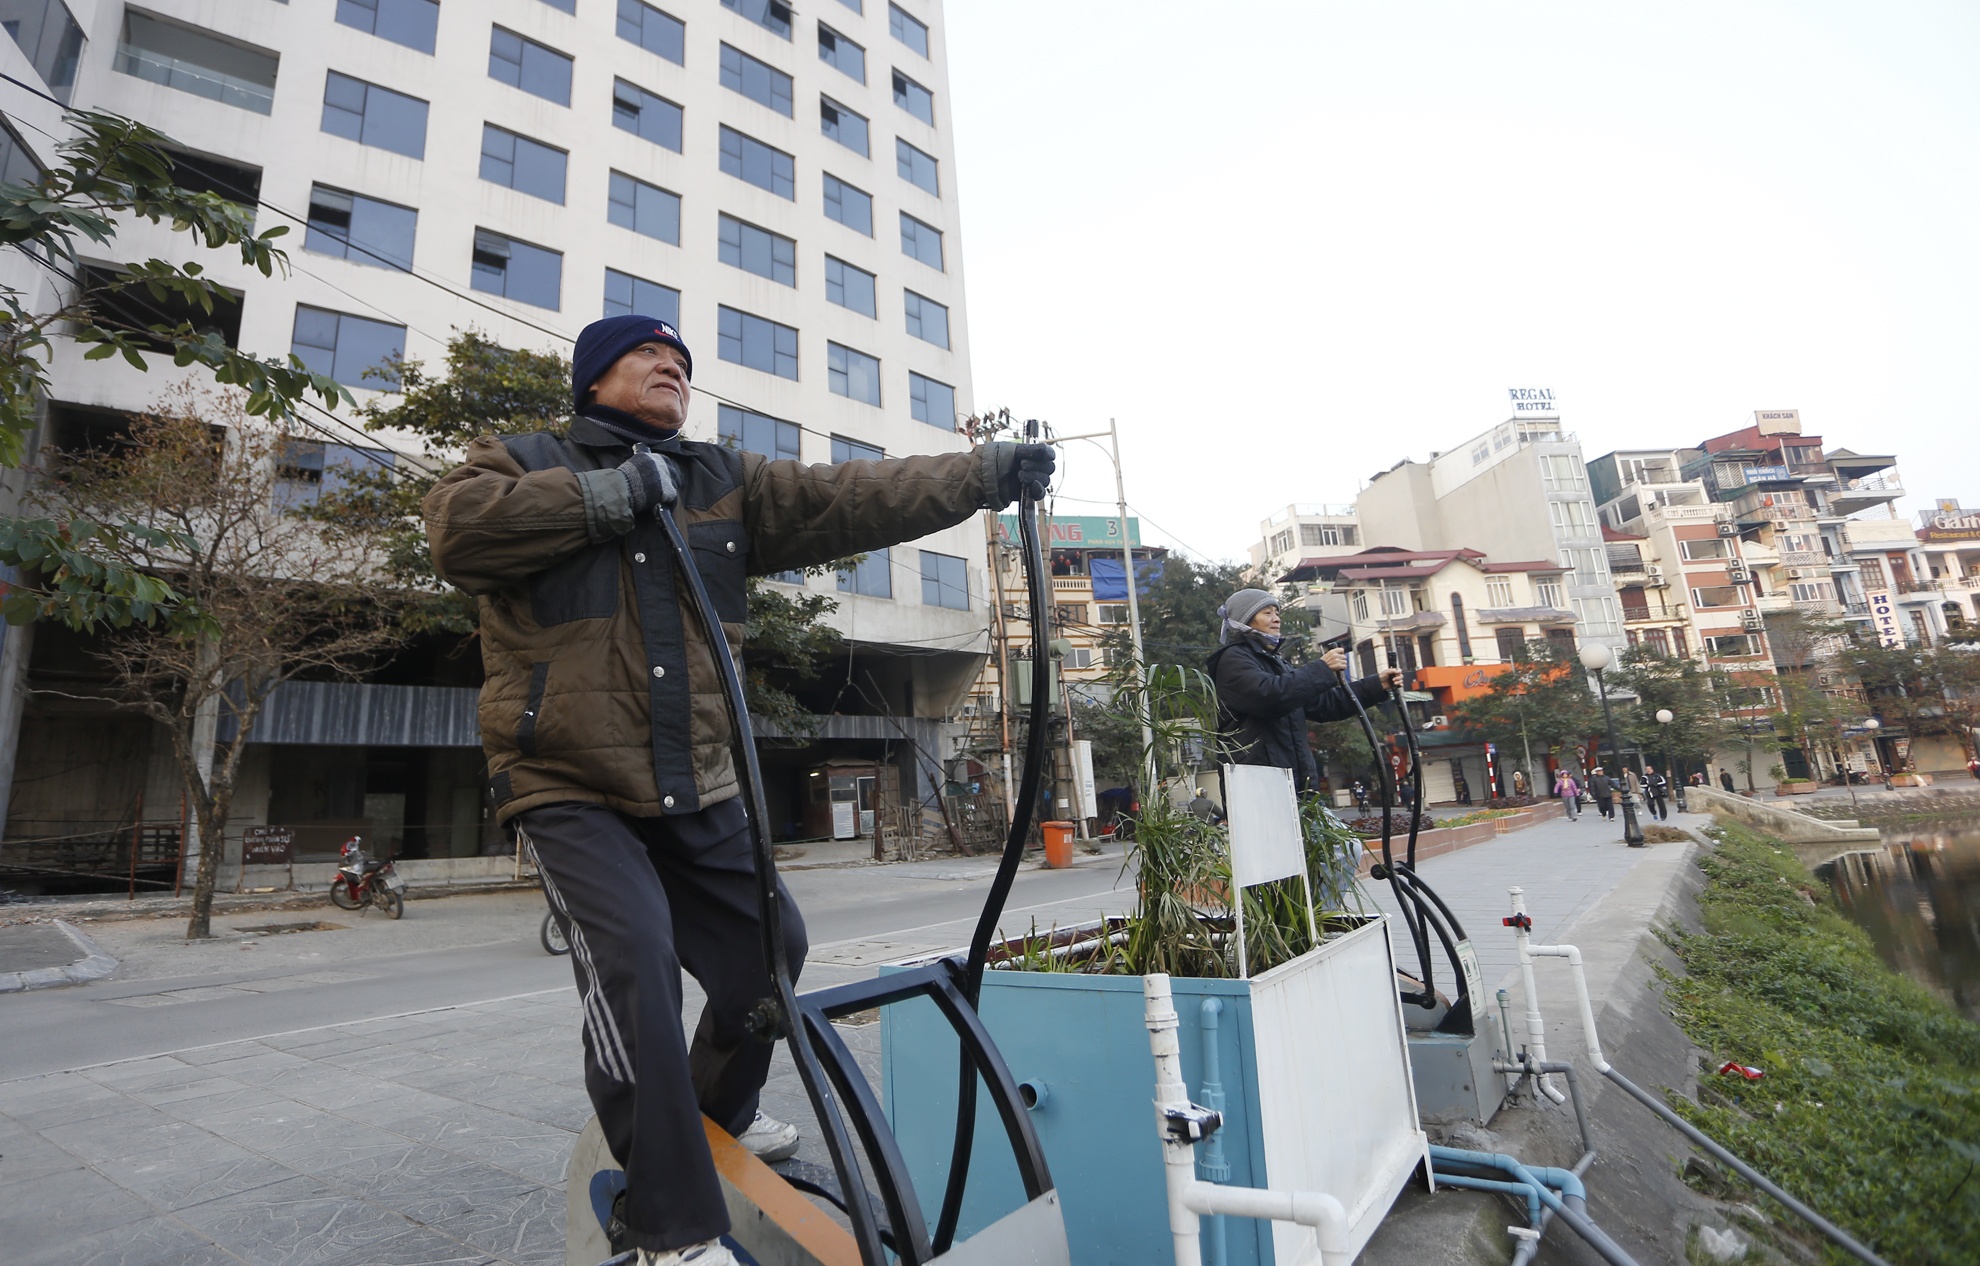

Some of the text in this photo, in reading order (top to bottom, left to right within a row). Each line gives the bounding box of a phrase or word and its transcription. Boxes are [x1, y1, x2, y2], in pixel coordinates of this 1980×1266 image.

[1508, 388, 1555, 400] REGAL
[1516, 402, 1555, 411] HOTEL
[1106, 520, 1118, 537] 3
